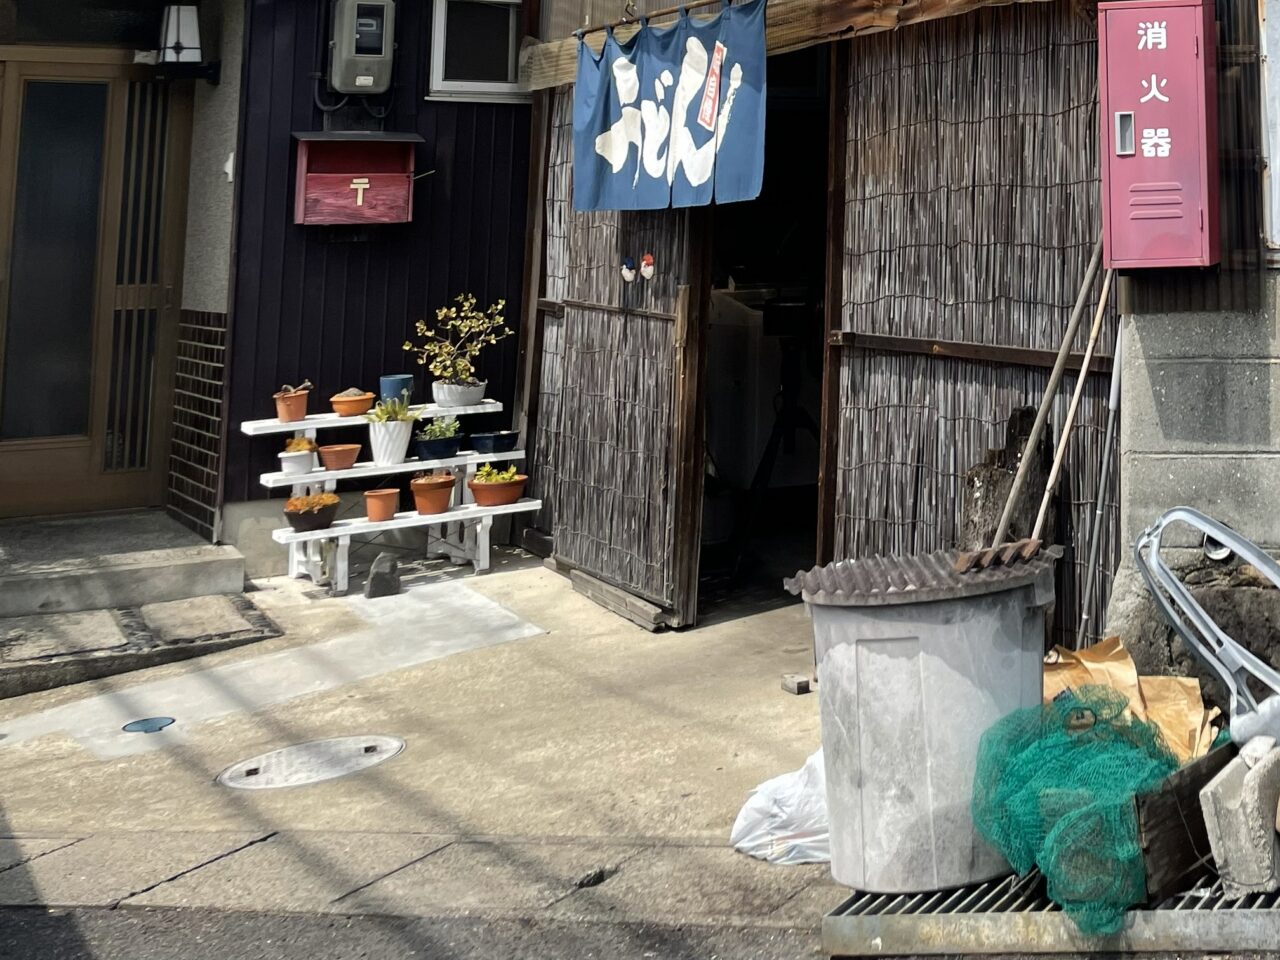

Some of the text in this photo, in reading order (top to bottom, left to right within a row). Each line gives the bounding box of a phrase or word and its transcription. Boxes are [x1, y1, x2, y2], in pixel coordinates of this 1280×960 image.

[595, 36, 743, 190] うどん
[1136, 20, 1172, 158] 消火器
